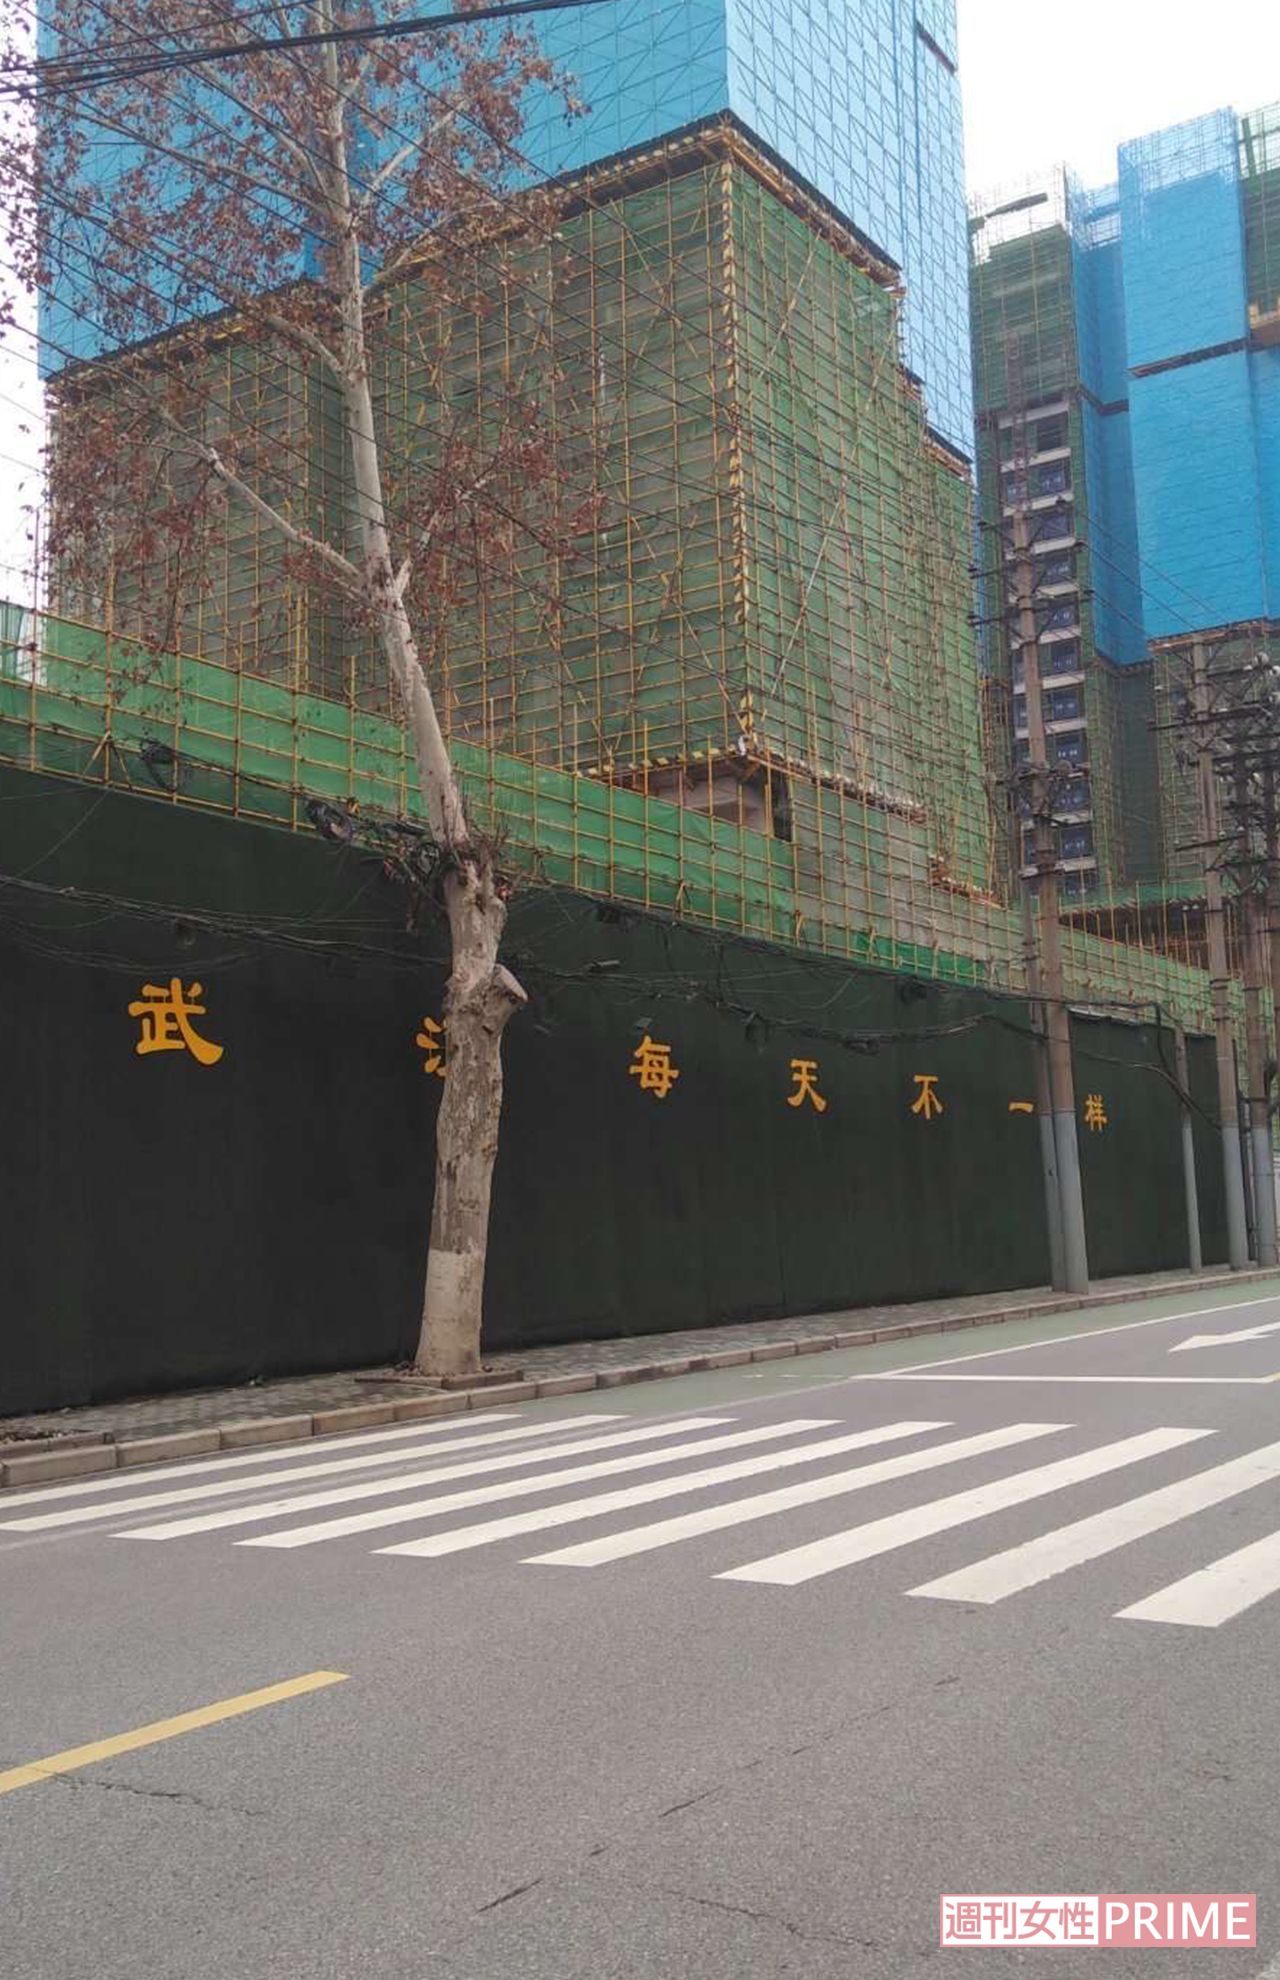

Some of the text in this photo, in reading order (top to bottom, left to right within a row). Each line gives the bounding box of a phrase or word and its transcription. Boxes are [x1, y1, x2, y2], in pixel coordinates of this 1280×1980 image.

[128, 977, 1107, 1131] 武每天不一样
